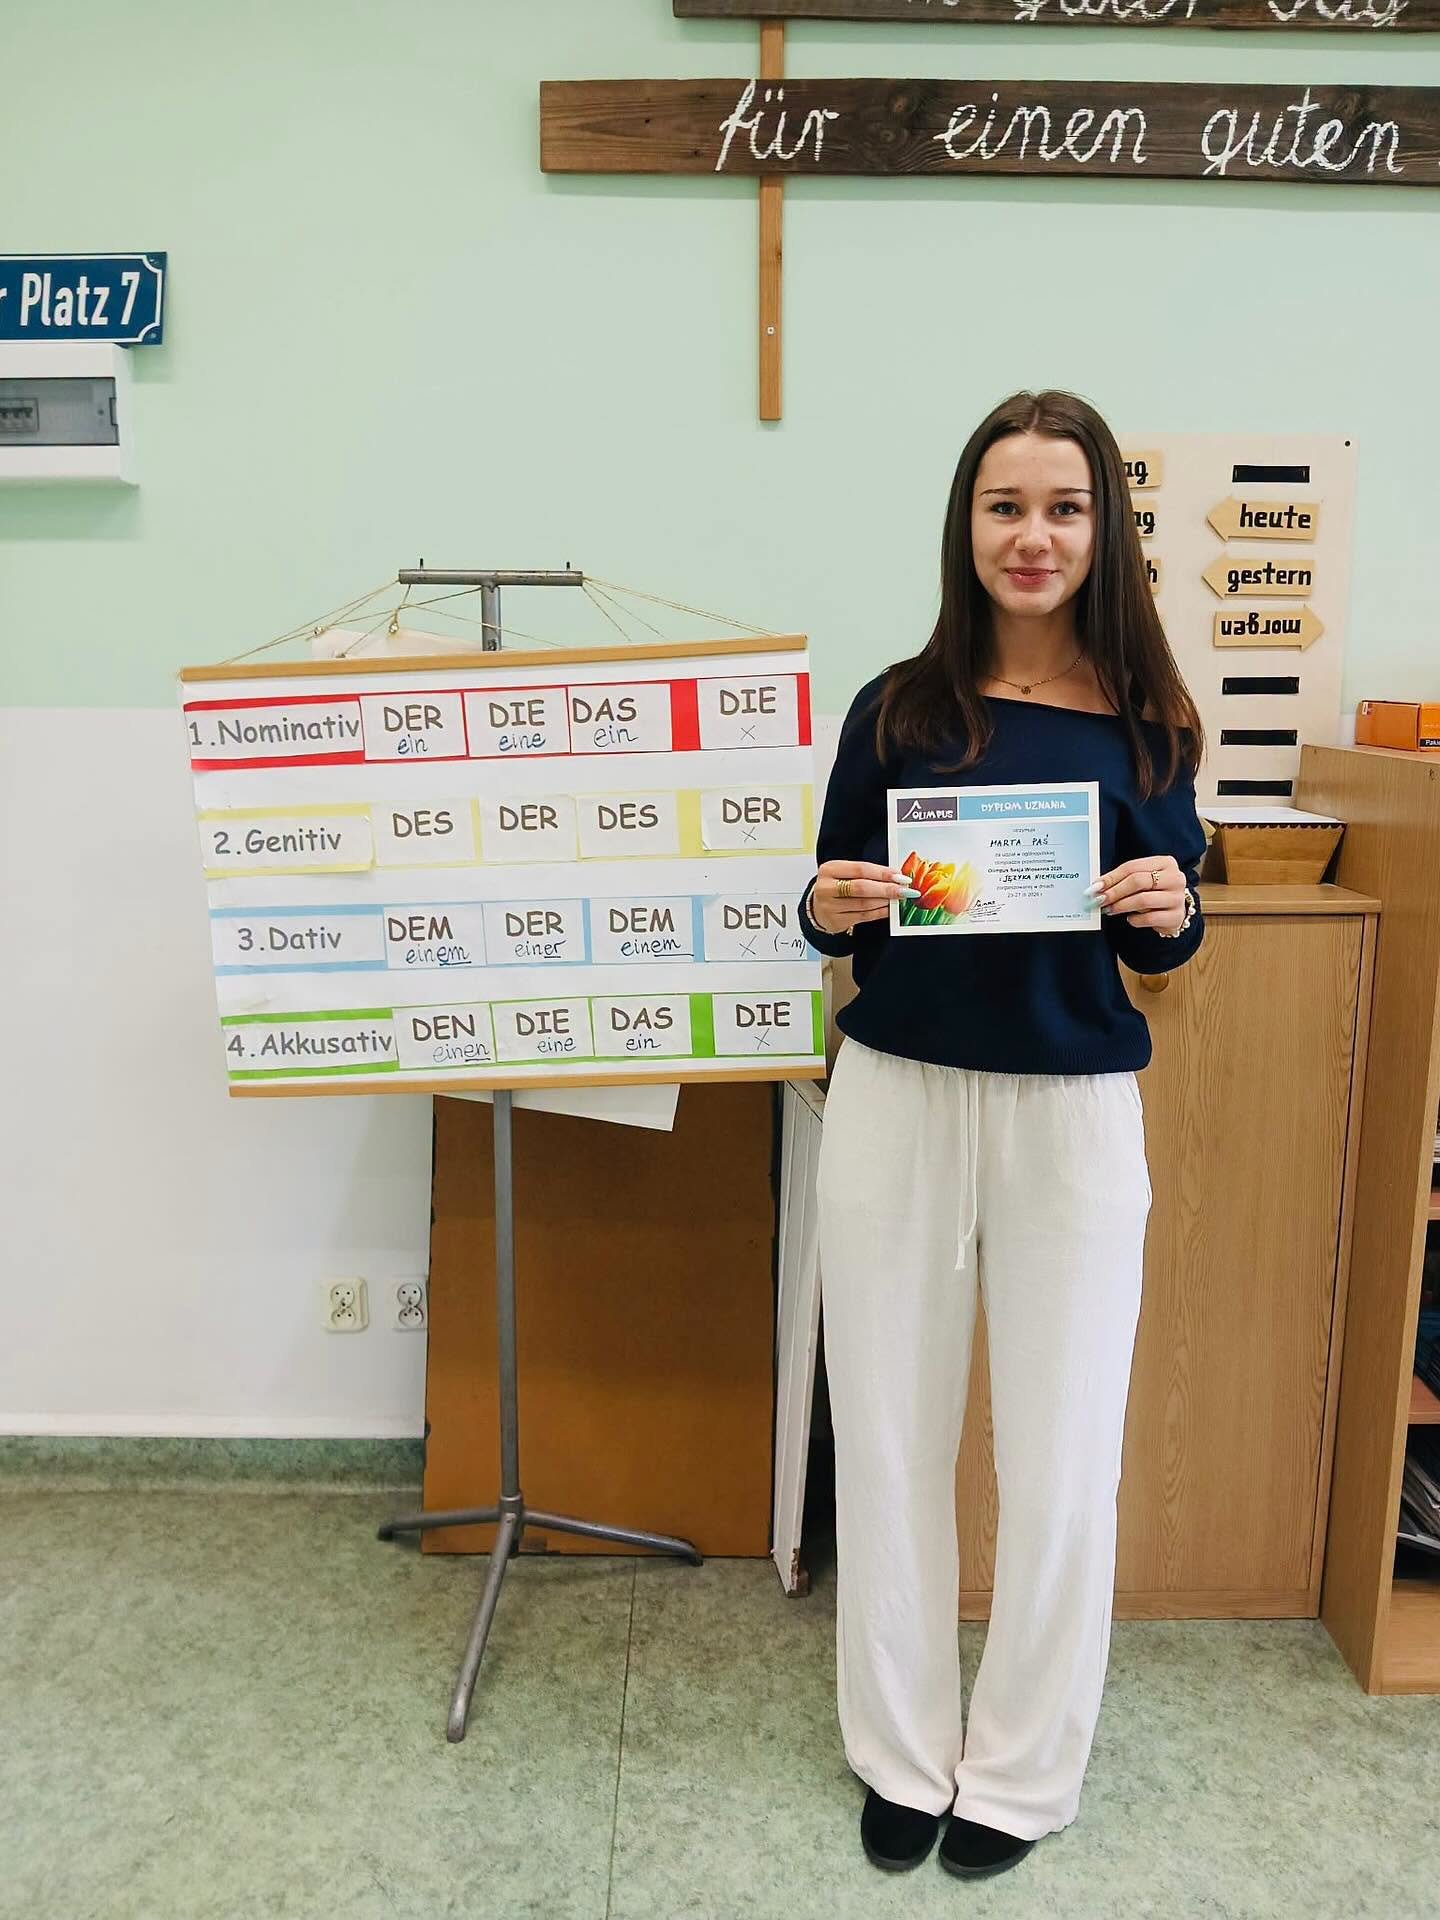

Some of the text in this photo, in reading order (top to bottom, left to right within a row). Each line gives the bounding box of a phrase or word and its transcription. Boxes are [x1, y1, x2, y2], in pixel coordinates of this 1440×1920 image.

[715, 78, 1404, 176] für einen guten
[20, 272, 110, 326] Platz
[120, 271, 140, 326] 7
[1239, 503, 1311, 530] heute
[1227, 562, 1312, 593] gestern
[1220, 612, 1301, 636] morgen
[384, 704, 443, 732] DER
[489, 699, 545, 728] DIE
[572, 697, 637, 724] DAS
[720, 686, 777, 716] DIE
[397, 734, 428, 755] ein
[498, 732, 546, 752] eine
[593, 726, 639, 748] ein
[392, 810, 453, 838] DES
[499, 804, 559, 831] DER
[598, 803, 659, 830] DES
[722, 797, 782, 825] DER
[912, 810, 954, 820] OLIMPUS
[981, 800, 1066, 812] DYPLOM UZNANIA
[990, 839, 1021, 847] MARTA
[388, 916, 453, 942] DEM
[506, 910, 564, 937] DER
[609, 907, 675, 933] DEM
[723, 903, 787, 930] DEN
[406, 944, 471, 965] einem
[514, 939, 567, 958] einer
[620, 936, 683, 956] einem
[412, 1014, 476, 1042] DEN
[516, 1008, 570, 1036] DIE
[611, 1006, 674, 1032] DAS
[736, 1001, 791, 1028] DIE
[433, 1042, 490, 1061] einen
[537, 1037, 576, 1054] eine
[626, 1034, 661, 1051] ein
